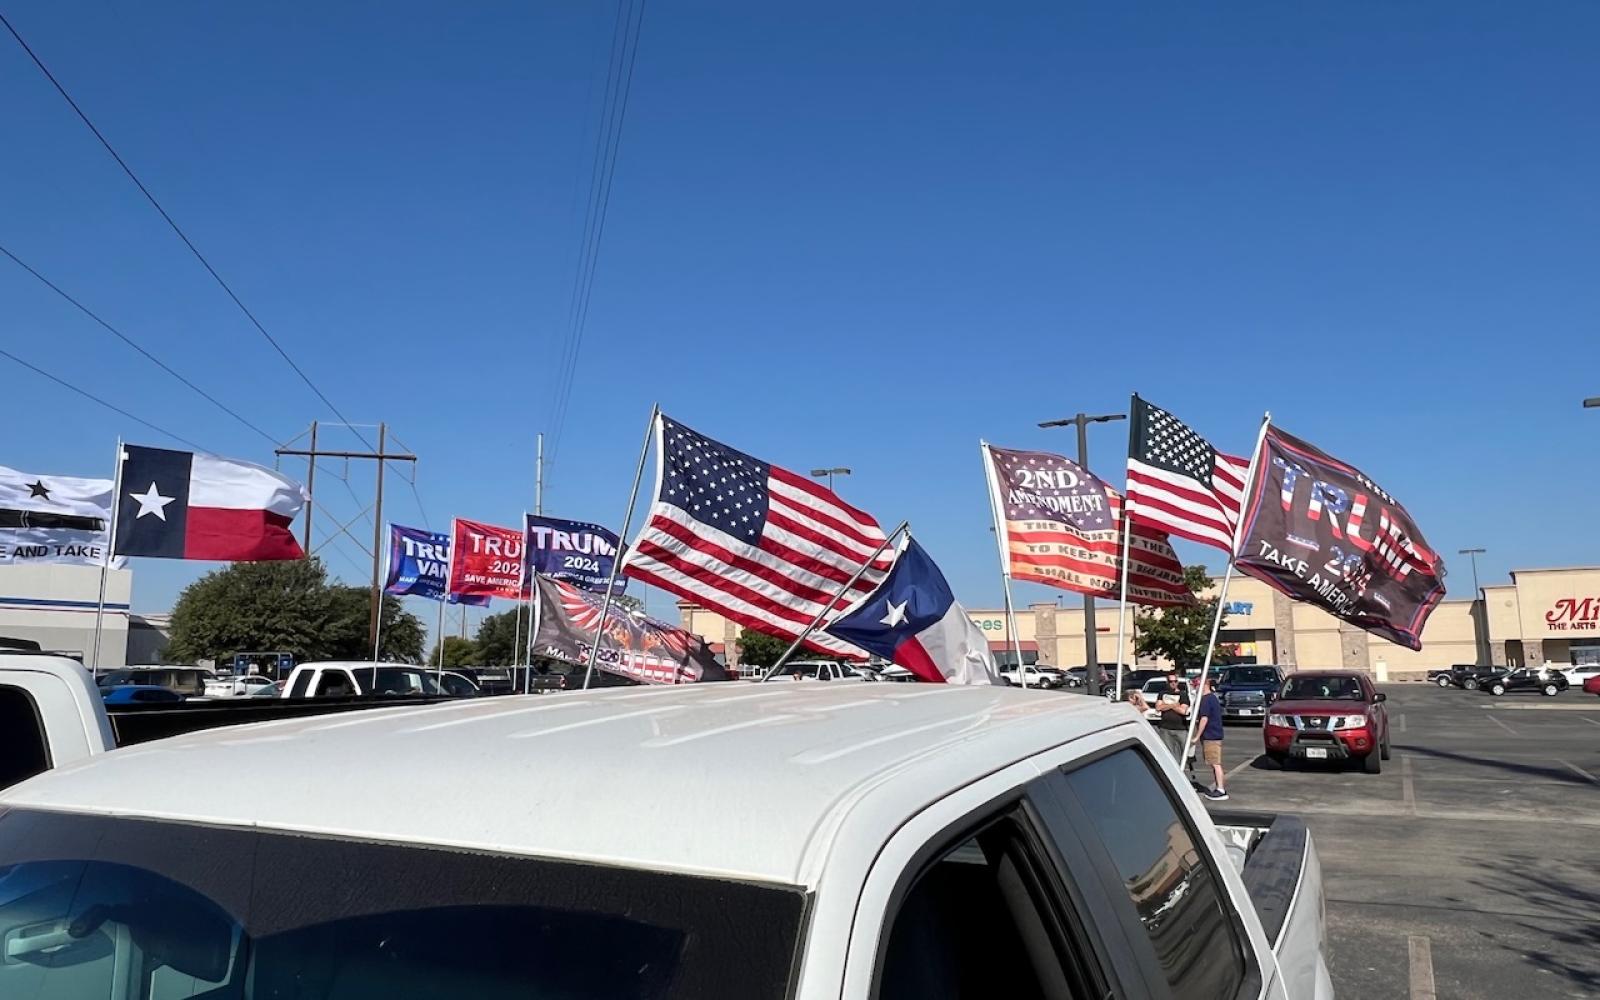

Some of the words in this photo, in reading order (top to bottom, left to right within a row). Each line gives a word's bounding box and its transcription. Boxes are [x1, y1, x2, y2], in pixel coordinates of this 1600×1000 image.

[1015, 469, 1078, 490] 2ND
[1008, 488, 1103, 514] AMENDMENT
[1024, 522, 1058, 530] THE
[1064, 525, 1115, 541] RIGHT
[13, 545, 48, 558] AND
[54, 545, 101, 559] TAKE
[470, 533, 520, 558] TRU
[1026, 544, 1051, 553] TO
[1058, 545, 1099, 560] KEEP
[564, 556, 600, 573] 2024
[1258, 539, 1309, 578] TAKE
[464, 574, 486, 584] SAVE
[1033, 567, 1082, 584] SHALL
[1570, 622, 1596, 630] ARTS
